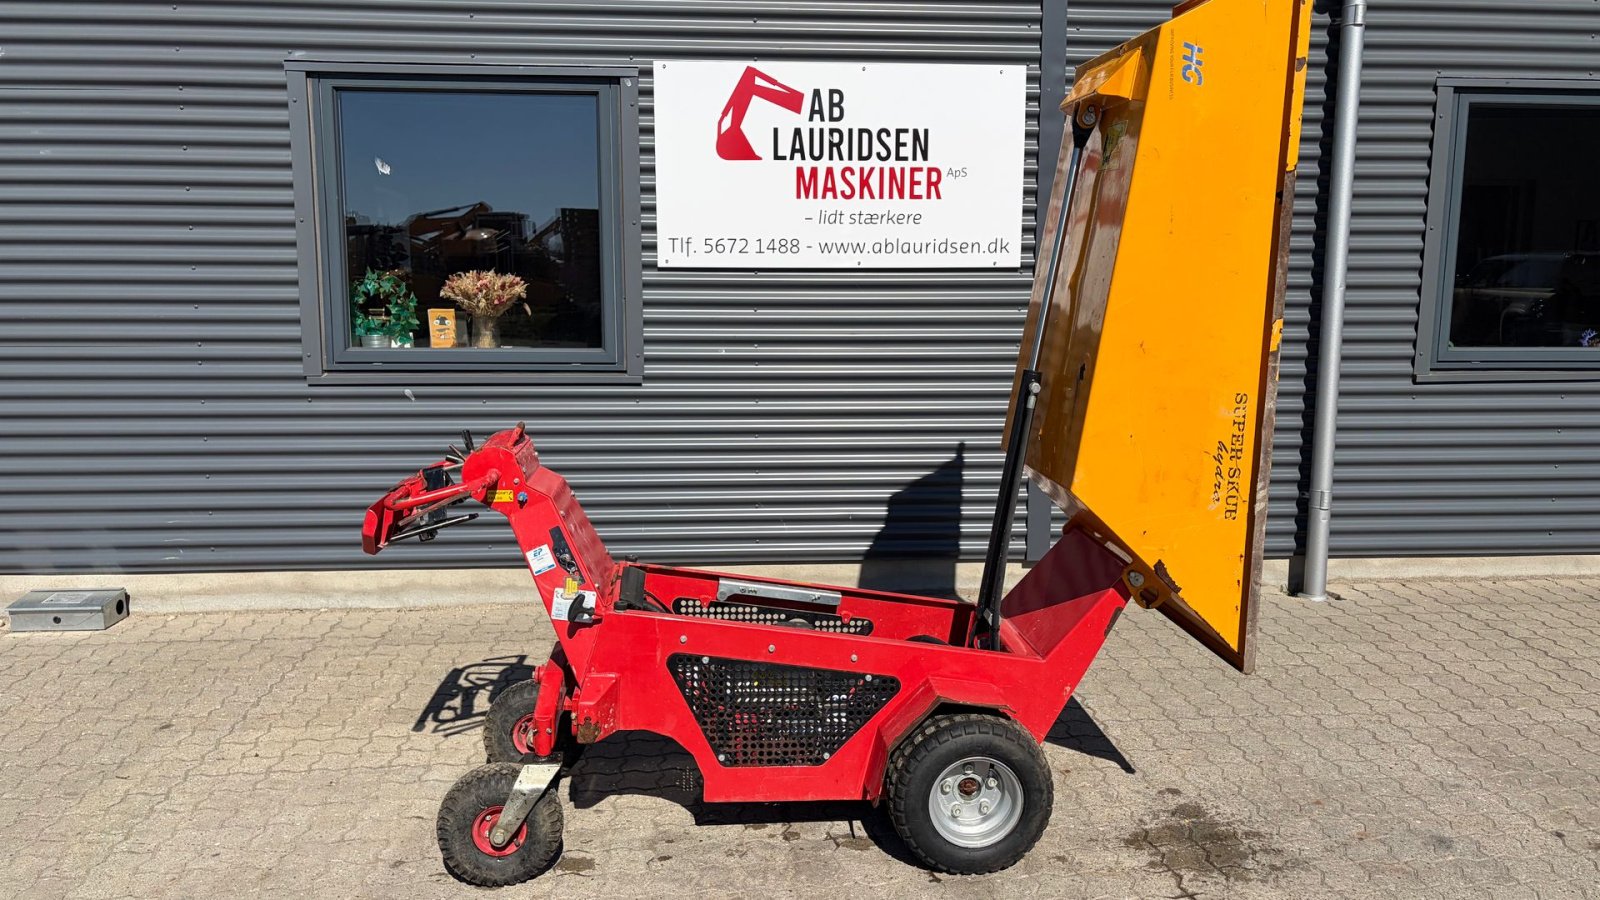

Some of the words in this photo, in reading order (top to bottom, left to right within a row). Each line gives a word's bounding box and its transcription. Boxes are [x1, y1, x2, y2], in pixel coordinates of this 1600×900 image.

[1182, 41, 1203, 86] HG
[808, 88, 844, 122] AB
[773, 127, 929, 162] LAURIDSEN
[795, 166, 942, 200] MASKINER
[947, 167, 967, 180] ApS
[818, 210, 844, 225] lidt
[848, 210, 922, 225] stærkere
[668, 237, 697, 257] Tlf.
[704, 238, 749, 254] 5672
[755, 238, 801, 254] 1488
[819, 237, 1010, 255] www.ablauridsen.dk
[1229, 393, 1248, 461] SUPER
